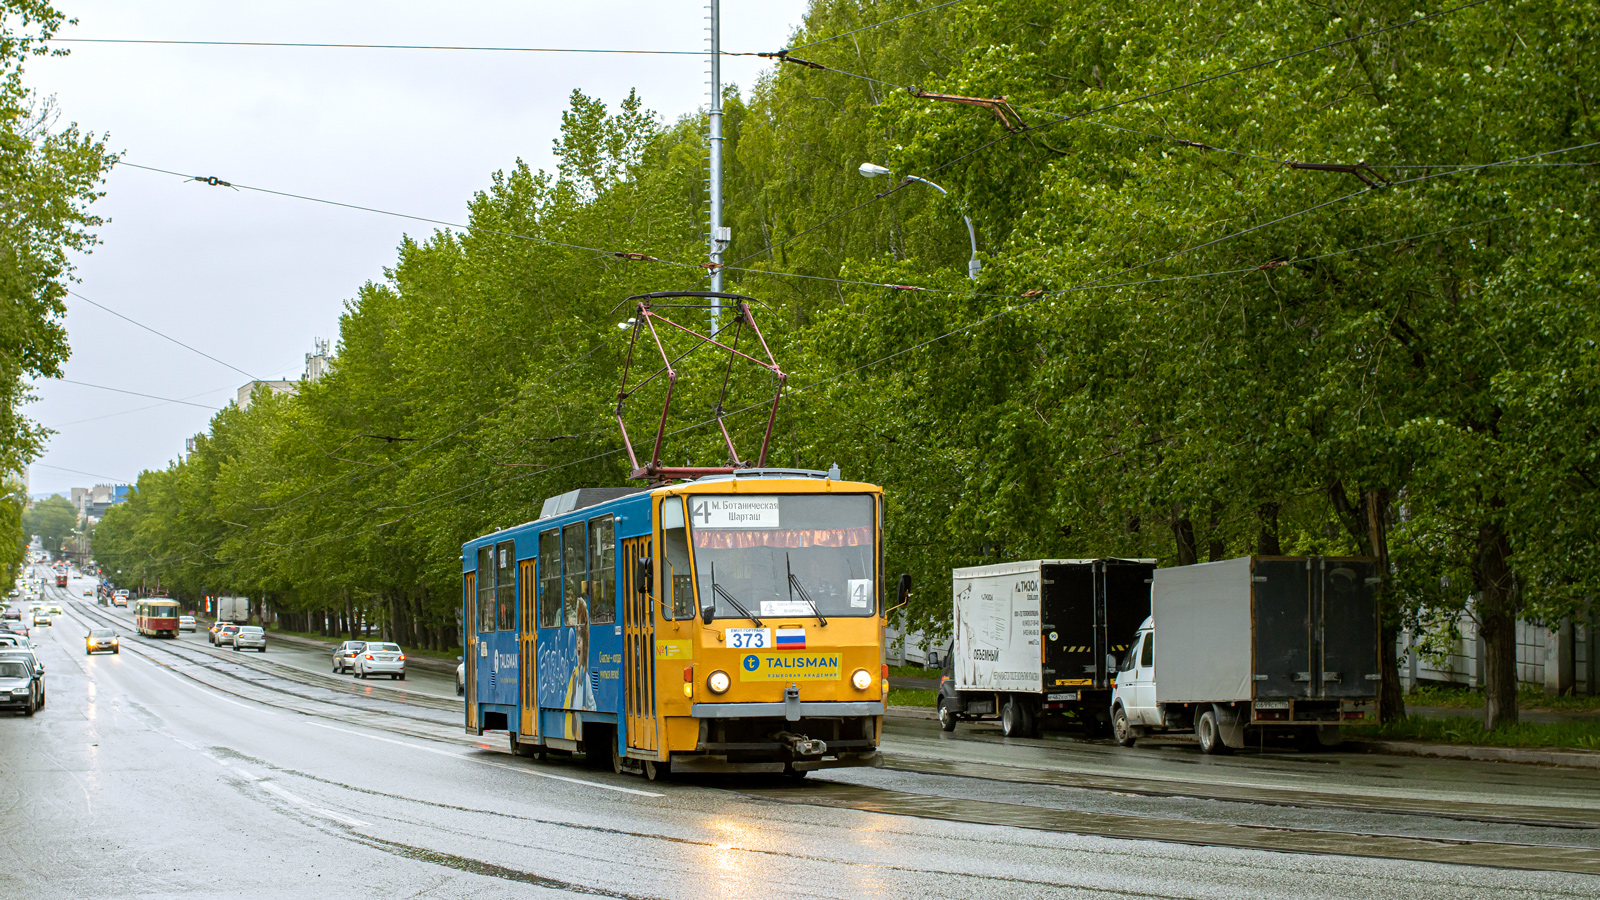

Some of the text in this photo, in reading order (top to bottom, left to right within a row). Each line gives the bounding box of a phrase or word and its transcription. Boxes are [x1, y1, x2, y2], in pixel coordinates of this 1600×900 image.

[693, 501, 711, 524] 4
[712, 501, 778, 510] М. Ботаническая
[729, 512, 760, 522] Шарташ
[853, 584, 866, 601] 4
[1021, 580, 1038, 592] ТИЗОЛ
[733, 633, 764, 648] 373
[500, 654, 518, 668] TALISMAN
[973, 648, 999, 662] ОБЪЕМНЫЙ
[766, 657, 838, 668] TALISMAN
